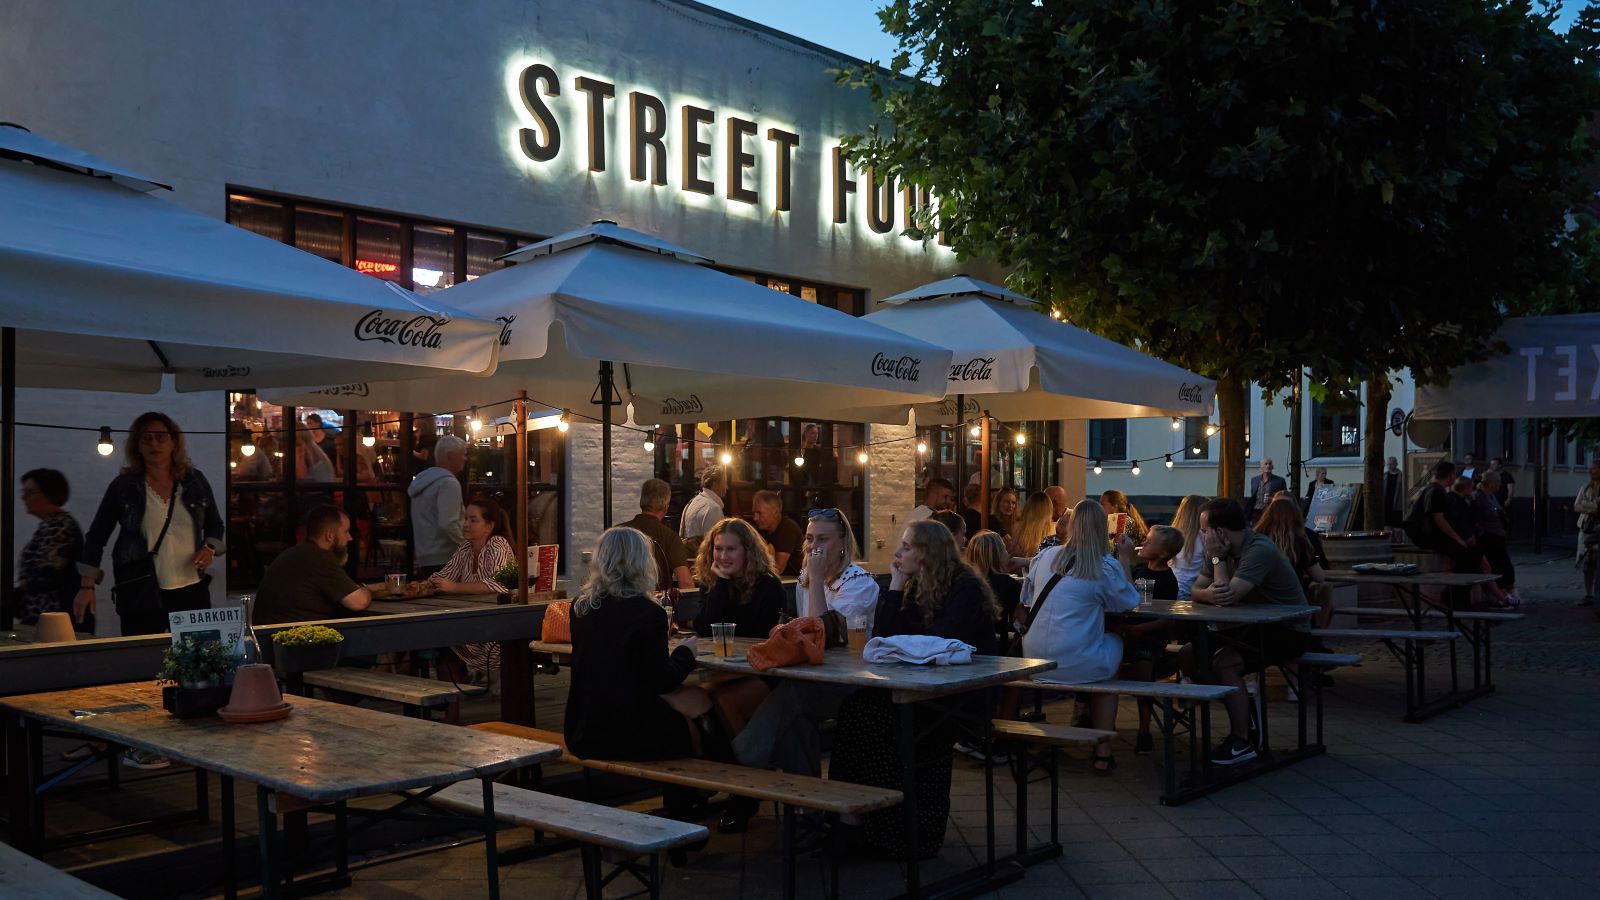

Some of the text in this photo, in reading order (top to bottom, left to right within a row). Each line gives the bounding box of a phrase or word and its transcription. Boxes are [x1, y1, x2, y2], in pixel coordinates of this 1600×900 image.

[519, 63, 952, 247] STREET FOO
[354, 309, 451, 349] Coca-Cola
[871, 351, 921, 382] Coca-Cola
[189, 609, 240, 624] BARKORT
